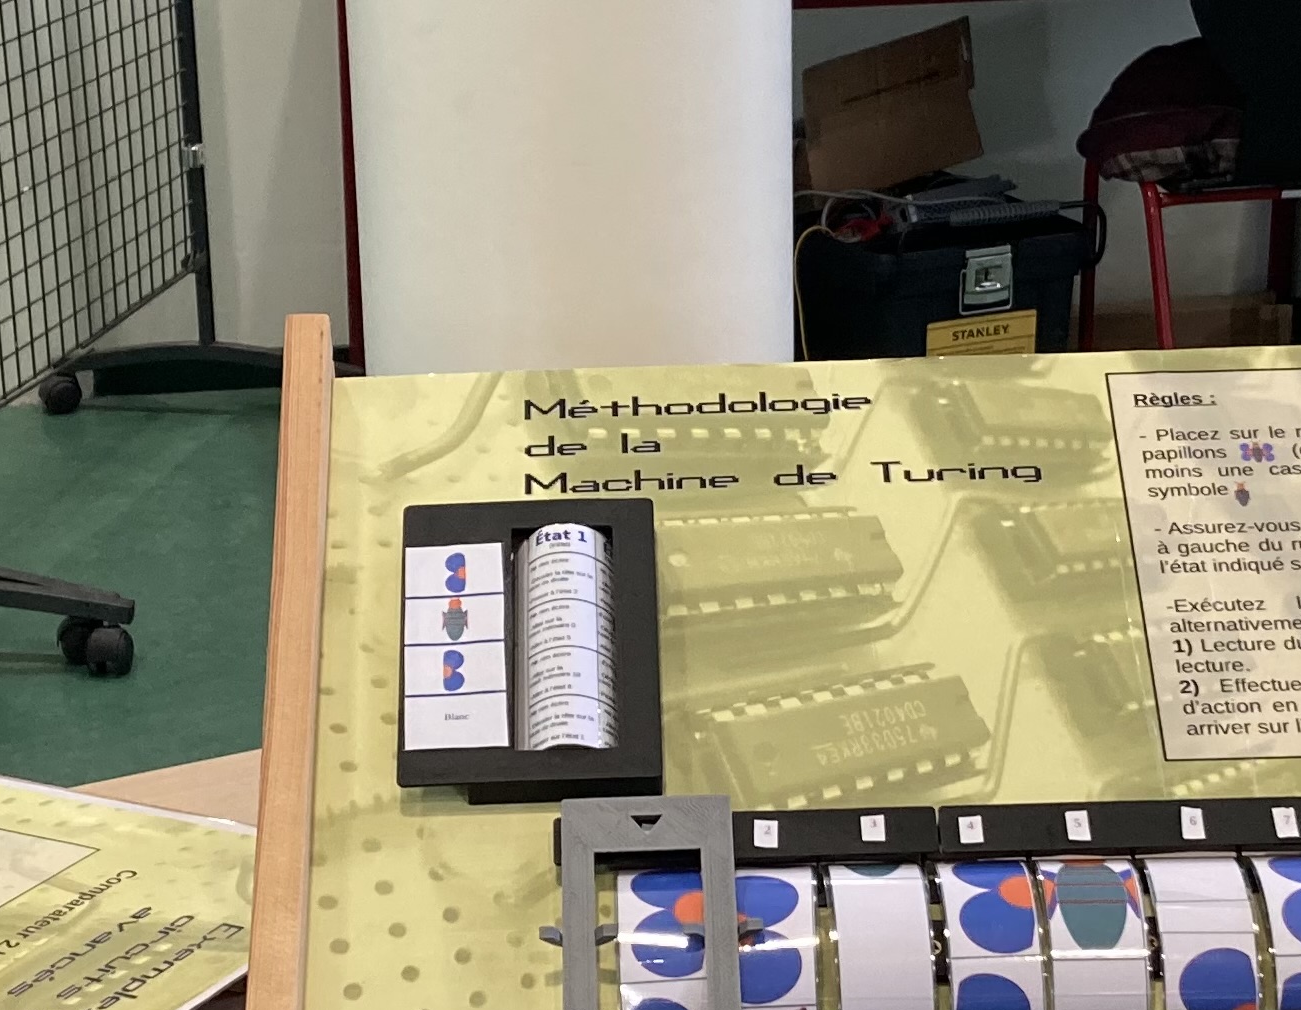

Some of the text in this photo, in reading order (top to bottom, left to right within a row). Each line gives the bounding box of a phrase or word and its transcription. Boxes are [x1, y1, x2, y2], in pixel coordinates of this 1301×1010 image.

[952, 324, 1010, 341] STANLEY
[524, 392, 871, 420] Méthodologie
[1133, 392, 1203, 408] Règles
[1155, 426, 1221, 442] Placez
[1230, 428, 1259, 440] sur
[1269, 425, 1286, 439] le
[524, 434, 660, 457] de la
[1143, 444, 1227, 463] papillons
[524, 461, 1042, 495] Machine de Turing
[1145, 464, 1202, 479] moins
[1217, 464, 1253, 476] une
[1148, 481, 1228, 501] symbole
[1169, 517, 1300, 536] Assurez-vous
[535, 529, 587, 547] État 1
[1157, 538, 1169, 554] à
[1177, 537, 1249, 557] gauche
[1258, 536, 1283, 551] du
[1213, 555, 1285, 575] indiqué
[1173, 637, 1193, 656] 1)
[1201, 636, 1275, 652] Lecture
[1176, 657, 1250, 674] lecture.
[1179, 677, 1200, 696] 2)
[1273, 700, 1298, 712] en
[1187, 718, 1252, 736] arriver
[1258, 720, 1289, 734] sur
[16, 870, 137, 940] Comparateur
[7, 907, 152, 997] avancés
[57, 914, 194, 1000] circuits
